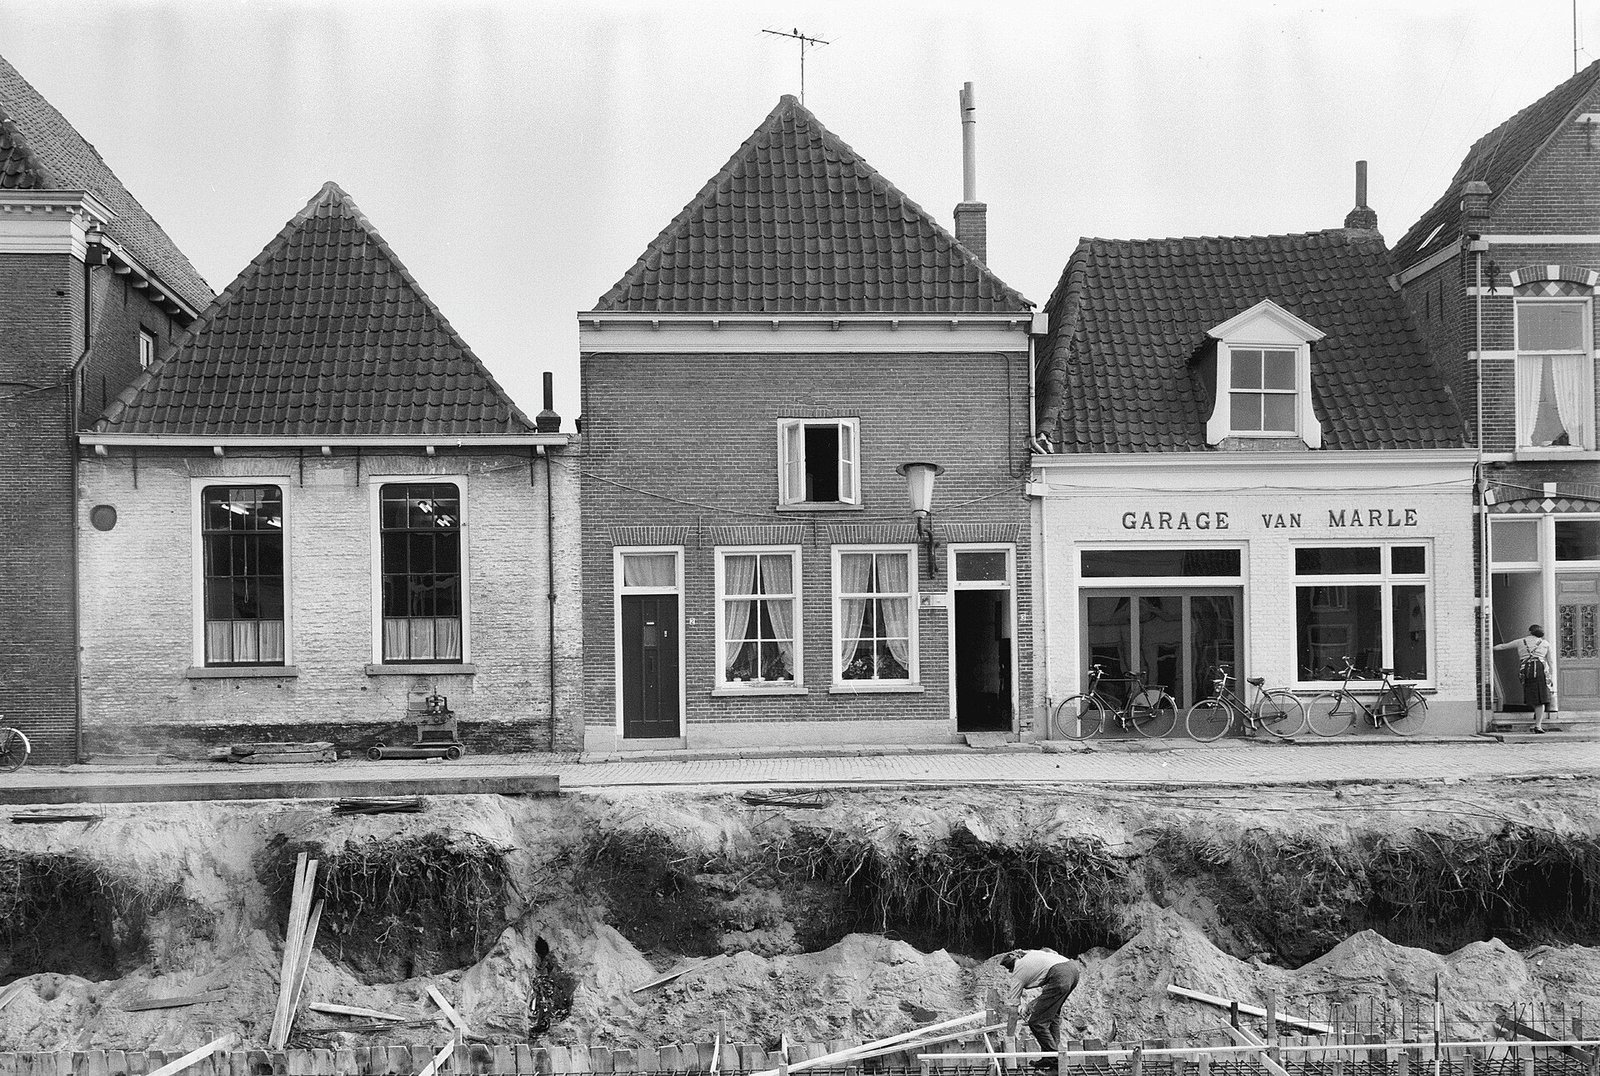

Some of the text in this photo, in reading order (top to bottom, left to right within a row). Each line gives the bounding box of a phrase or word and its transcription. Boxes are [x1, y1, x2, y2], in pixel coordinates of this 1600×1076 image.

[1122, 508, 1418, 530] GARAGE VAN MARLE
